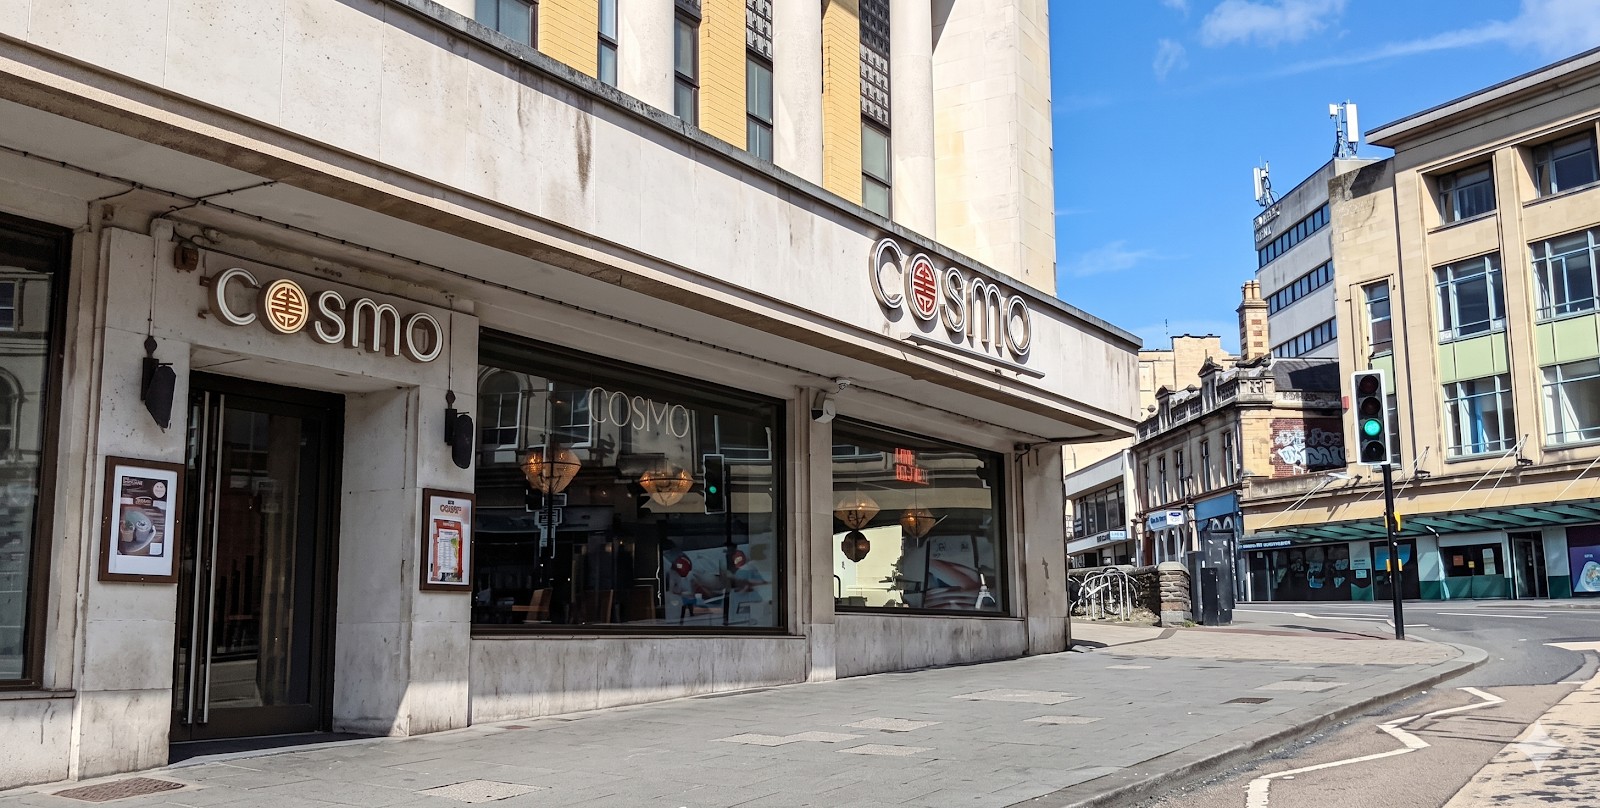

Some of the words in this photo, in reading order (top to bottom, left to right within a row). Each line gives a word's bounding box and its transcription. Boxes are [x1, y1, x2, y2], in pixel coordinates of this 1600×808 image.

[208, 267, 443, 363] COSMO
[868, 237, 1032, 356] COSMO
[588, 386, 690, 438] COSMO
